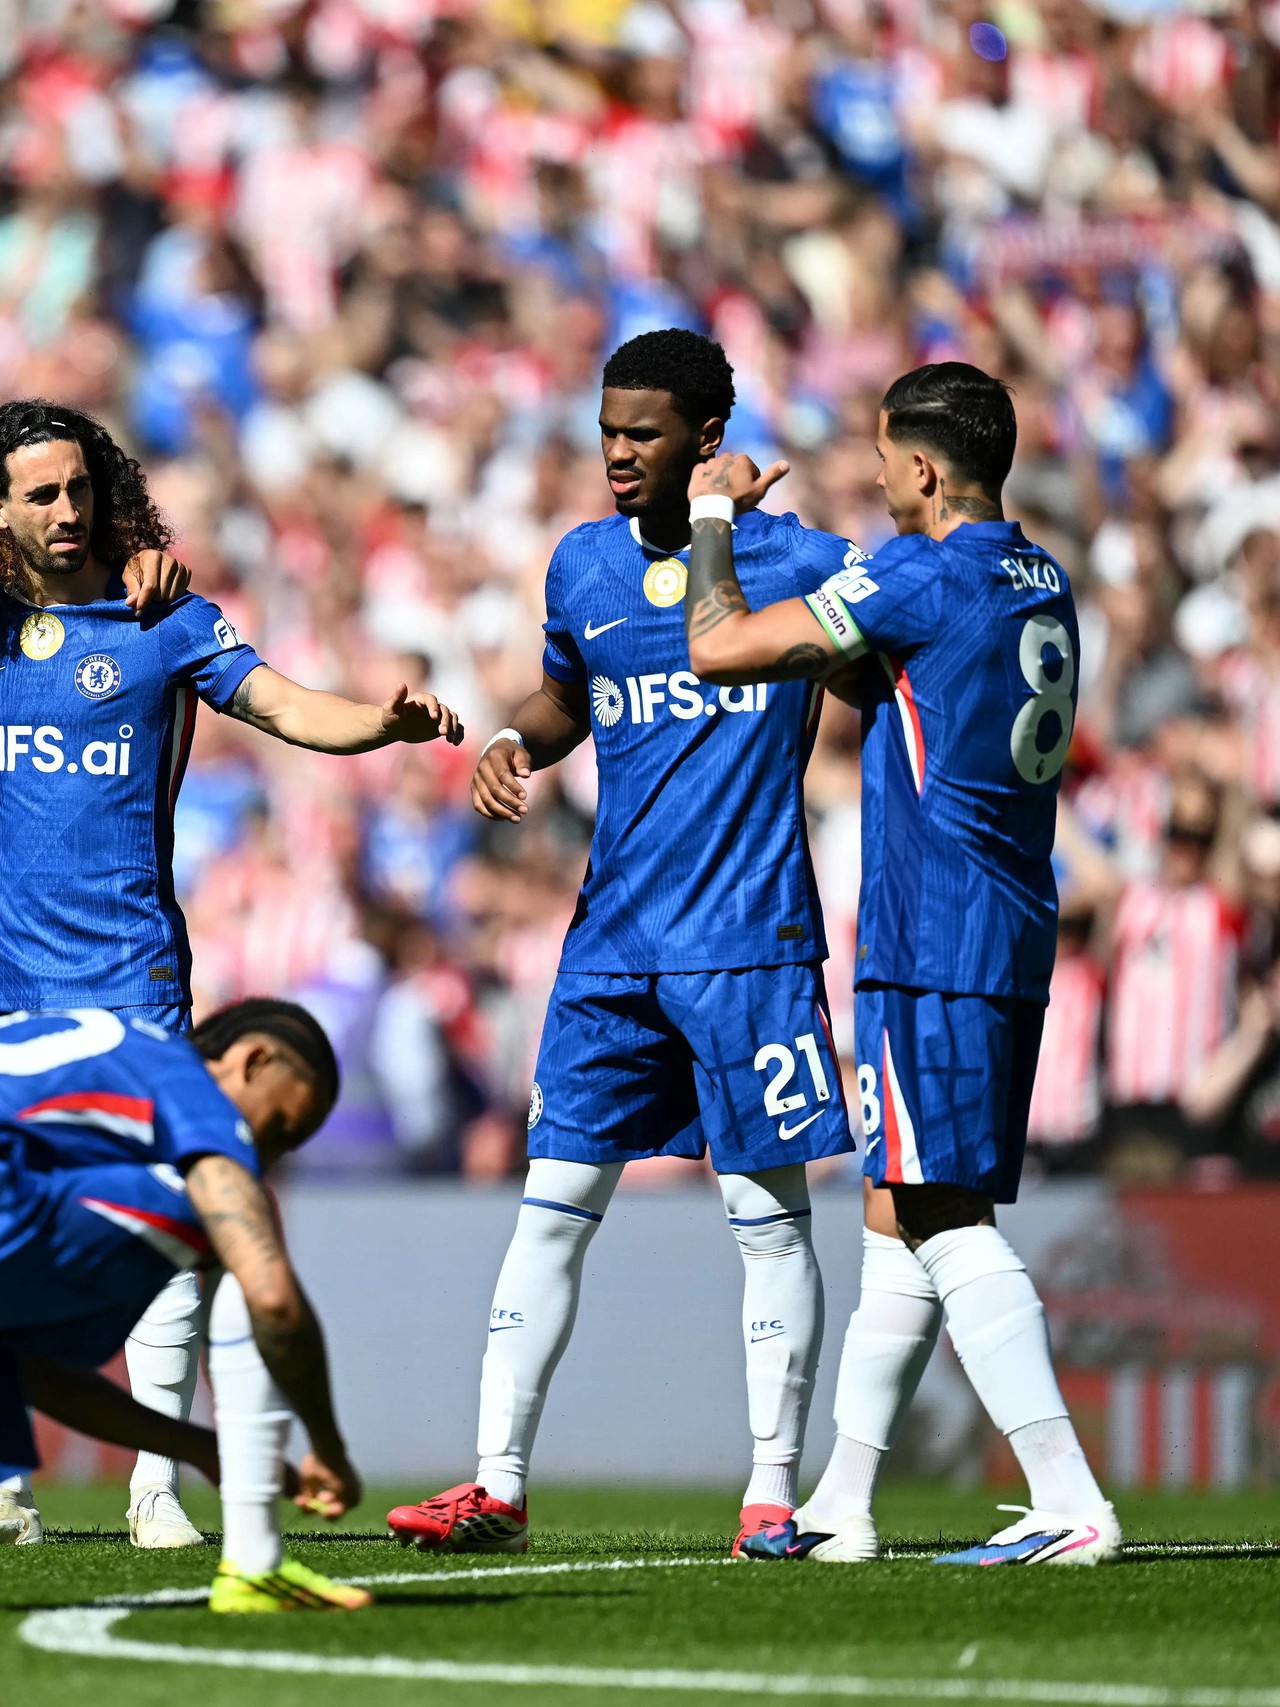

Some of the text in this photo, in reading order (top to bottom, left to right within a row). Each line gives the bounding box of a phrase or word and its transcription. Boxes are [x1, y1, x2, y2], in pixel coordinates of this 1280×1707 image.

[1000, 557, 1060, 593] ENZO
[816, 590, 847, 636] ptain
[84, 656, 114, 667] CHELSEA
[81, 688, 100, 697] FOOTBALL
[1010, 614, 1074, 785] 8
[754, 1033, 830, 1117] 21
[857, 1063, 880, 1136] 8
[492, 1308, 524, 1321] CFC
[752, 1320, 784, 1331] CFC
